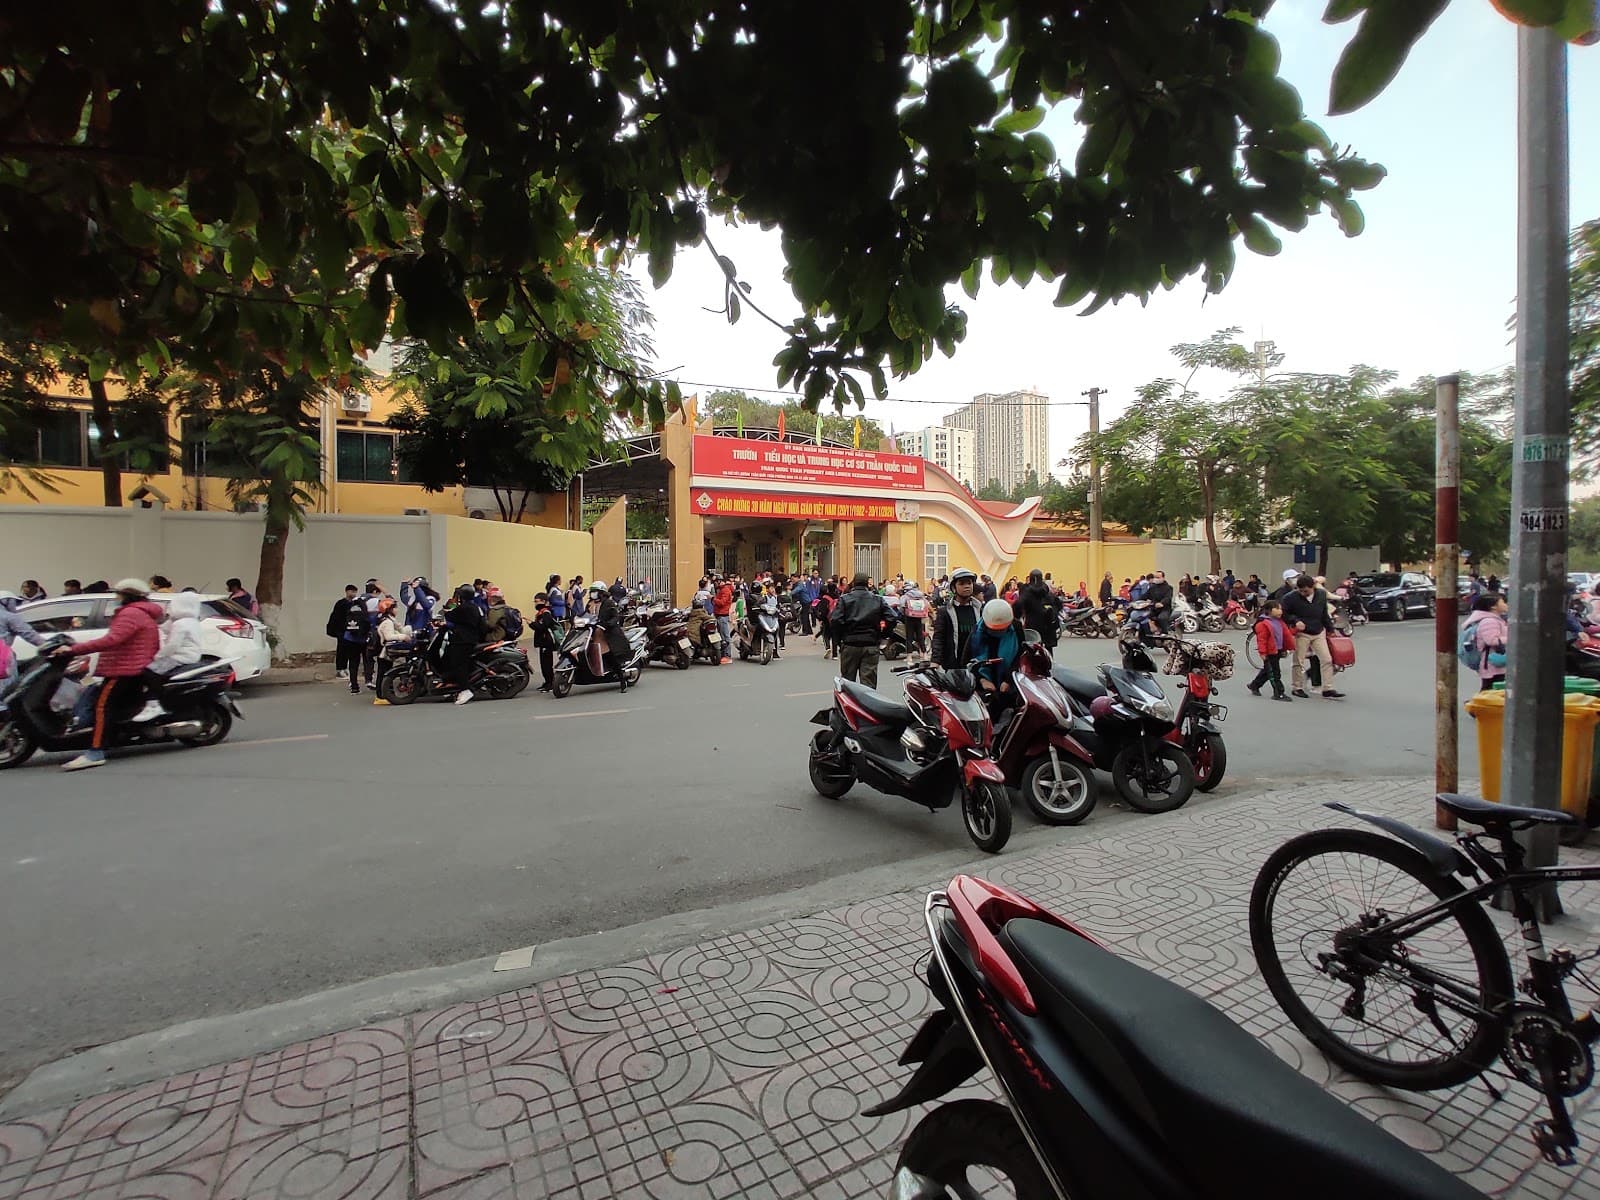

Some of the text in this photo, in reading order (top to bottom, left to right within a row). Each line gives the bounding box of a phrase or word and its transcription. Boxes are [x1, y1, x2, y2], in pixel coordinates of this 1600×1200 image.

[765, 449, 781, 463] TIỂU
[782, 454, 797, 466] HỌC
[798, 454, 806, 465] VÀ
[808, 456, 830, 467] TRUNG
[717, 497, 733, 512] CHÀO
[734, 498, 751, 513] MỪNG
[760, 499, 772, 513] NĂM
[773, 500, 787, 514] NGÀY
[789, 501, 800, 515] NHÀ
[801, 501, 813, 515] GIÁO
[814, 502, 825, 517] VIỆT
[826, 503, 837, 516] NAM
